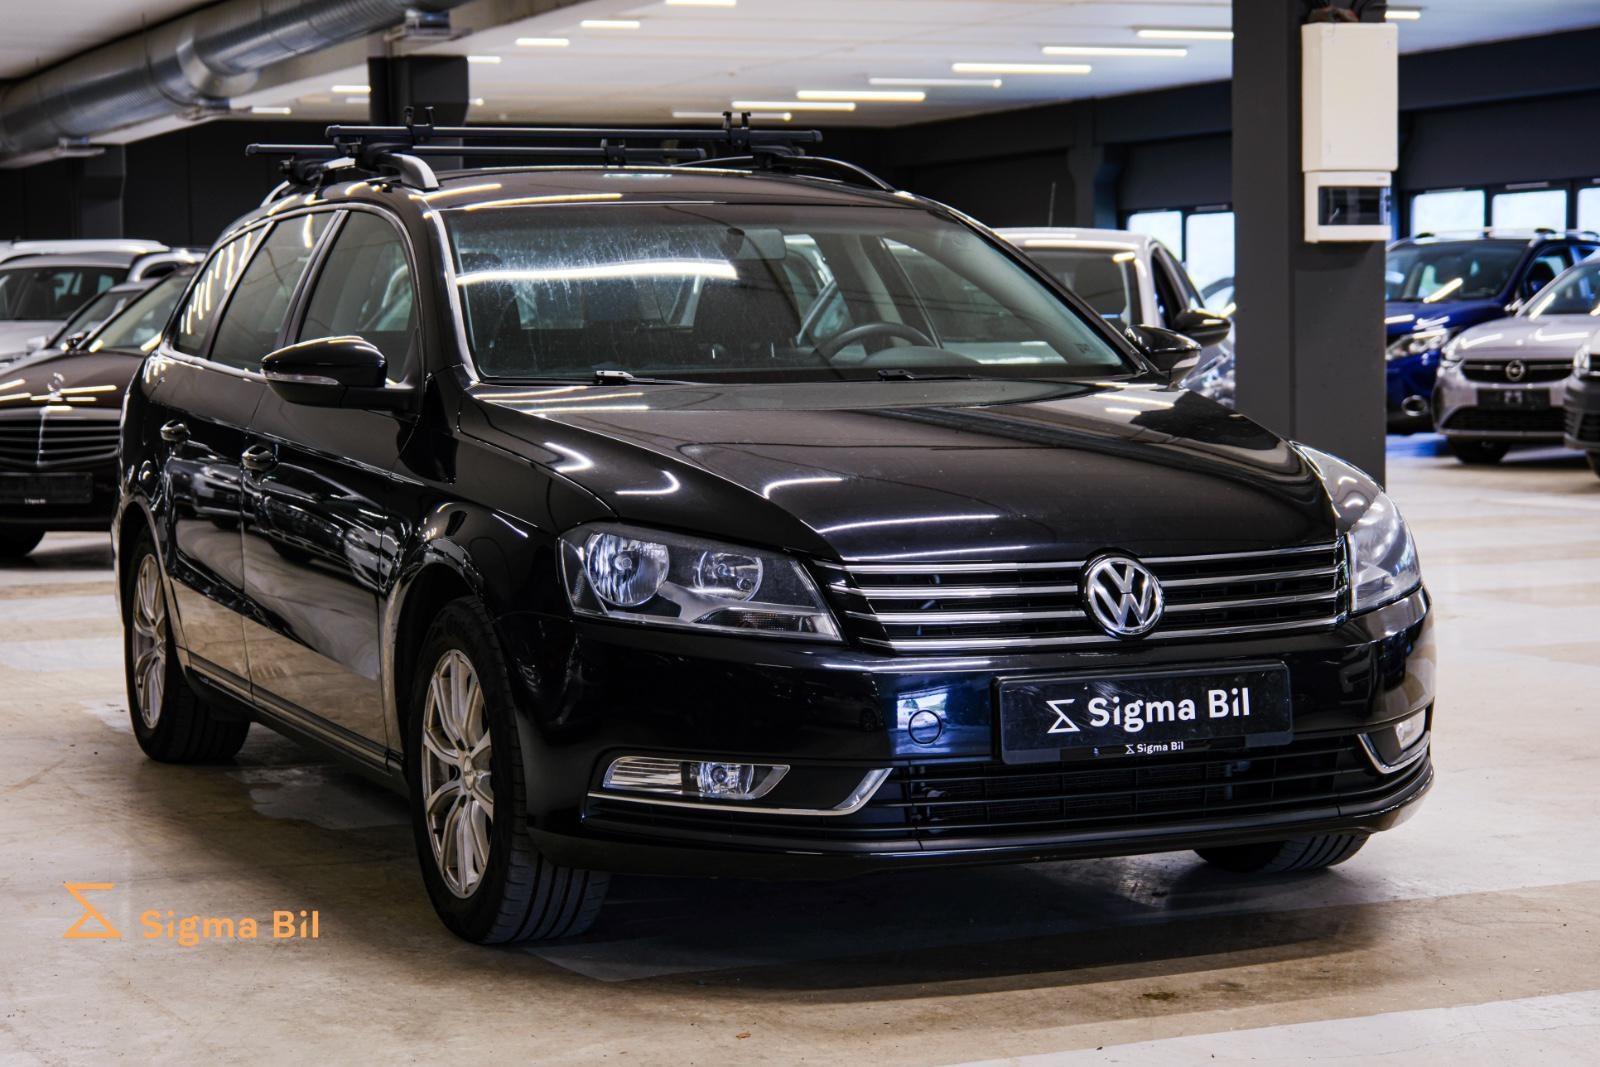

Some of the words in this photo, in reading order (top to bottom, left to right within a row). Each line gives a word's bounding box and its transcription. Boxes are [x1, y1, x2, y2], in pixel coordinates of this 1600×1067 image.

[1087, 696, 1196, 733] Sigma
[1207, 687, 1251, 718] Bil
[1136, 743, 1169, 755] Sigma
[1170, 741, 1184, 751] Bil
